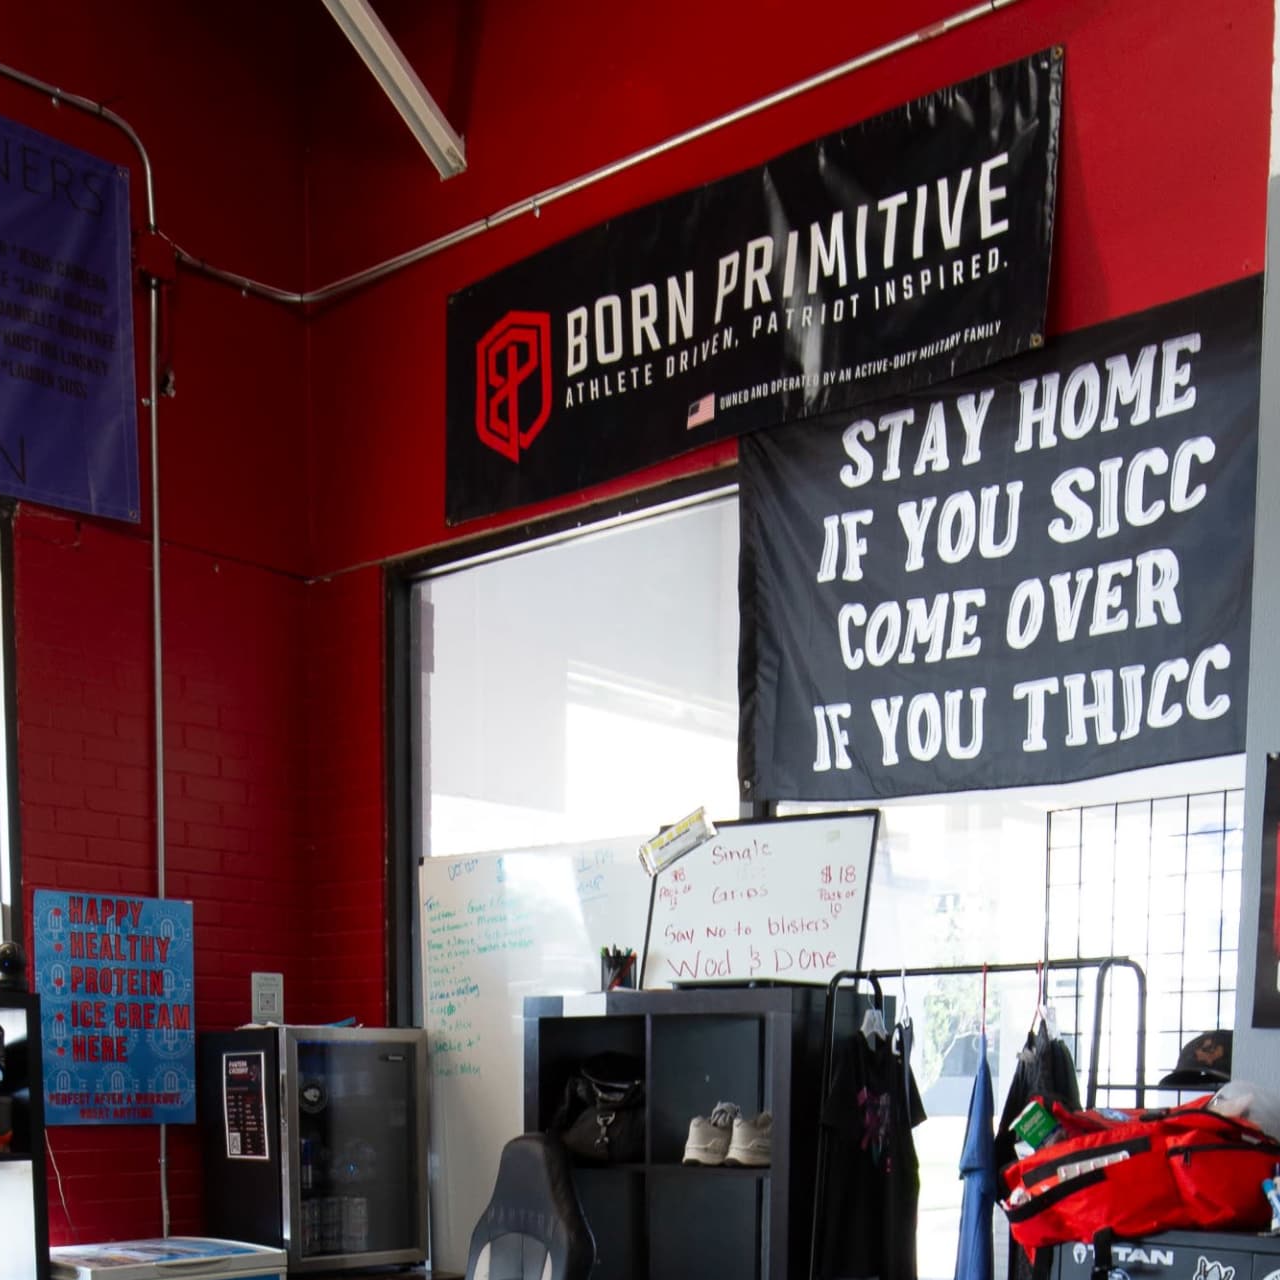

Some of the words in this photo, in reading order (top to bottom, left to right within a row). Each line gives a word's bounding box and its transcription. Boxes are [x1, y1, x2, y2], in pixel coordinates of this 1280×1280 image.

[566, 271, 695, 377] BORN
[714, 152, 1010, 323] PRIMITIVE
[565, 364, 654, 409] ATHLETE
[752, 293, 859, 338] PATRIOT
[874, 247, 1009, 309] INSPIRED.
[720, 391, 749, 411] OWNED
[751, 383, 769, 401] AND
[839, 367, 852, 382] AN
[854, 351, 919, 380] ACTIVE-DUTY
[919, 331, 961, 364] MILITARY
[963, 319, 1002, 344] FAMILY
[839, 388, 994, 489] STAY
[1014, 332, 1202, 453] HOME
[817, 509, 873, 583] IF
[897, 480, 1023, 573] YOU
[1047, 435, 1216, 544] SICC
[837, 588, 986, 671] COME
[1006, 547, 1182, 651] OVER
[813, 703, 851, 772] IF
[871, 687, 987, 767] YOU
[1013, 643, 1232, 752] THICC
[711, 840, 772, 865] Single
[712, 886, 769, 904] Grips
[69, 895, 144, 928] HAPPY
[664, 924, 695, 945] Say
[706, 925, 726, 938] No
[735, 920, 752, 936] to
[767, 916, 830, 936] blisters
[70, 931, 170, 963] HEALTHY
[70, 966, 164, 997] PROTEIN
[71, 1001, 106, 1029] ICE
[114, 1002, 191, 1030] CREAM
[72, 1035, 128, 1063] HERE
[1087, 1244, 1174, 1266] TTAN
